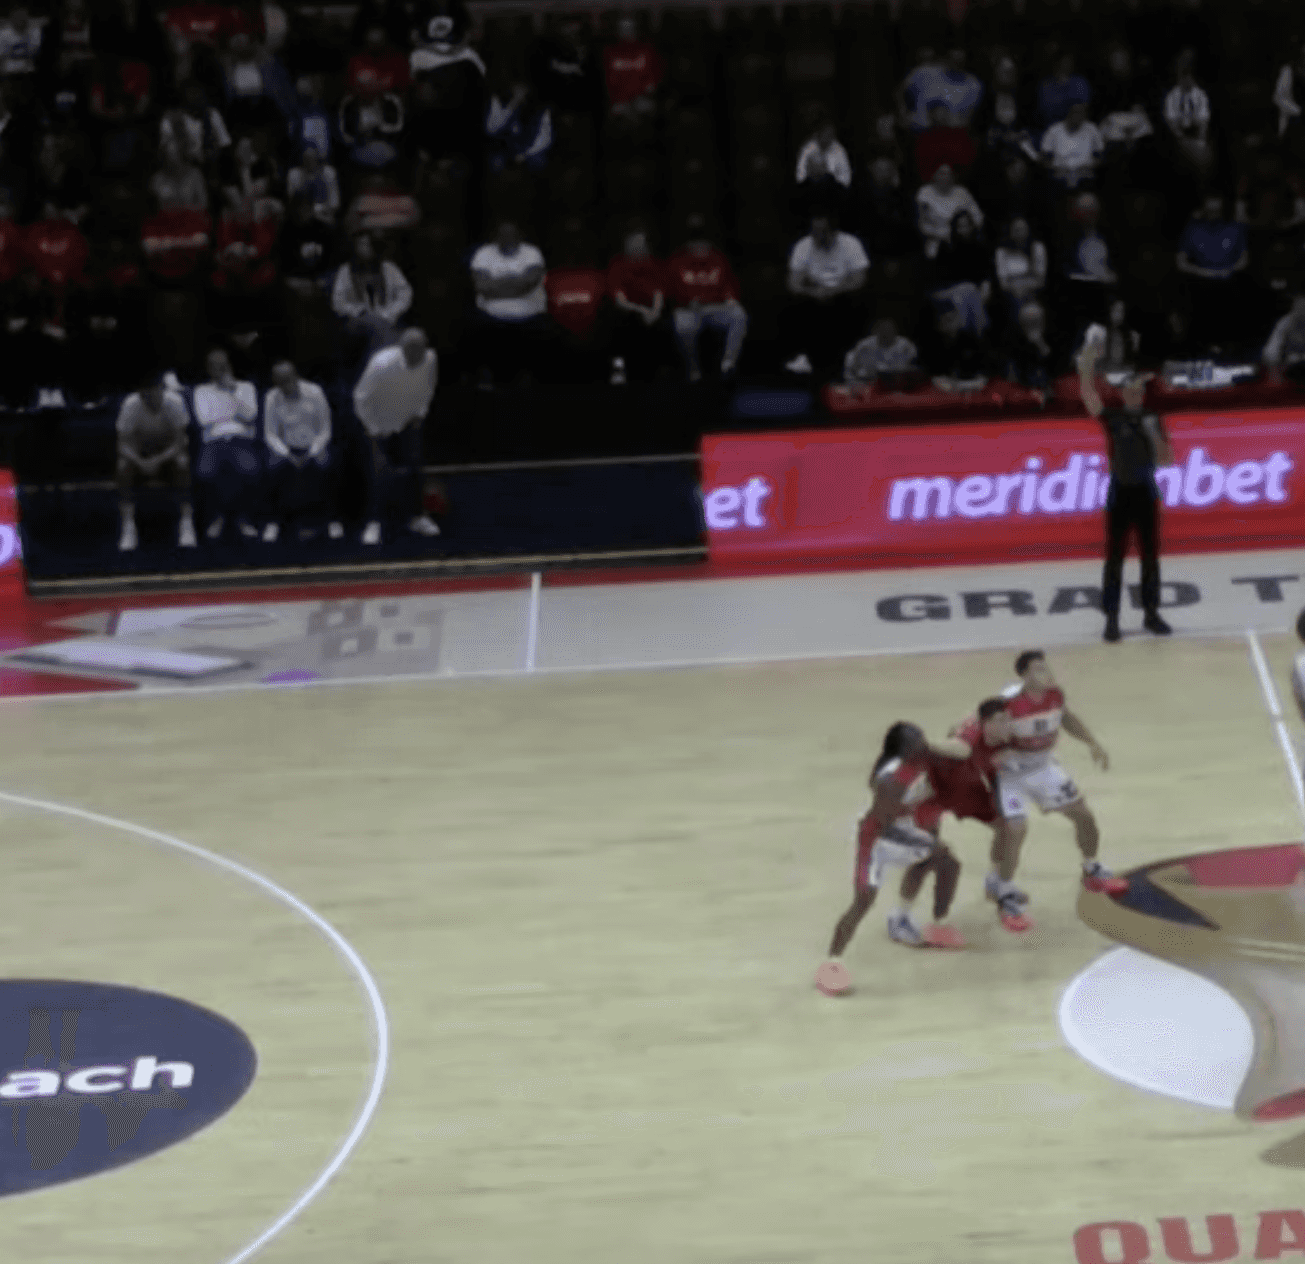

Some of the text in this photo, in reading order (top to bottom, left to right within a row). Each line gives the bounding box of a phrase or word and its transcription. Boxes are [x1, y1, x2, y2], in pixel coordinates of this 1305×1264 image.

[704, 477, 770, 528] et
[887, 447, 1293, 521] meridinbet
[875, 582, 1201, 622] GRAD
